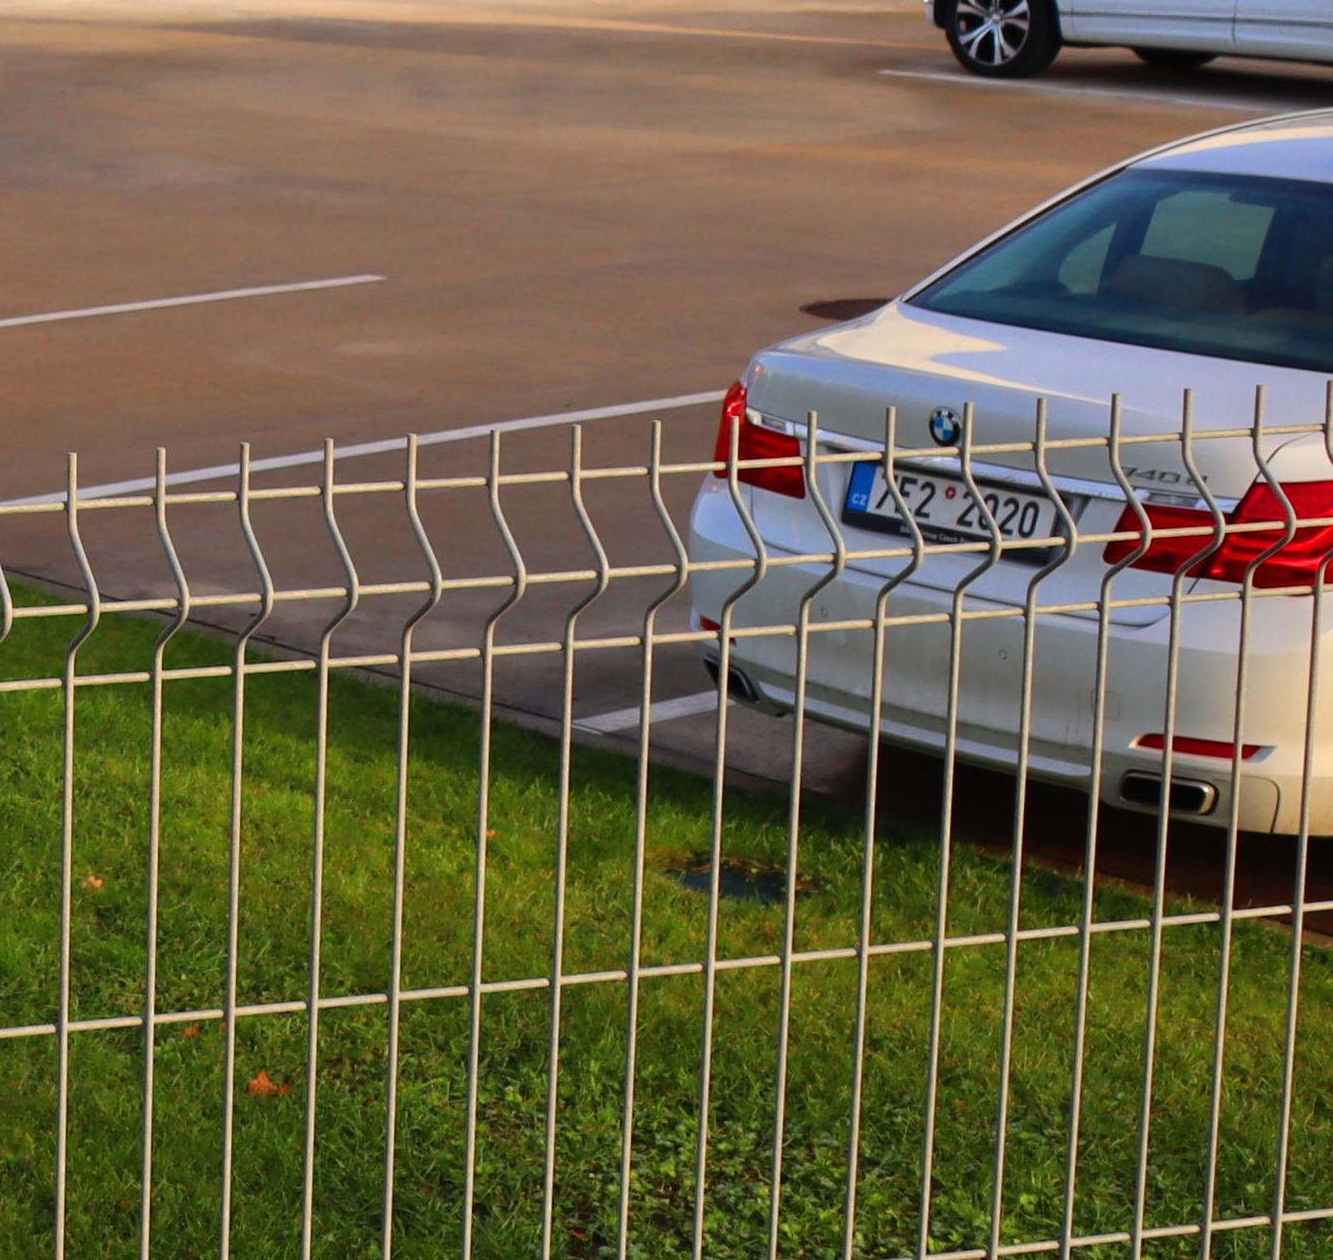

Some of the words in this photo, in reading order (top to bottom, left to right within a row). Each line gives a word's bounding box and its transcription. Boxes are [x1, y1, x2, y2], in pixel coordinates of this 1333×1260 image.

[852, 494, 867, 506] CZ
[875, 474, 937, 520] 7E2
[956, 489, 1040, 539] 2020
